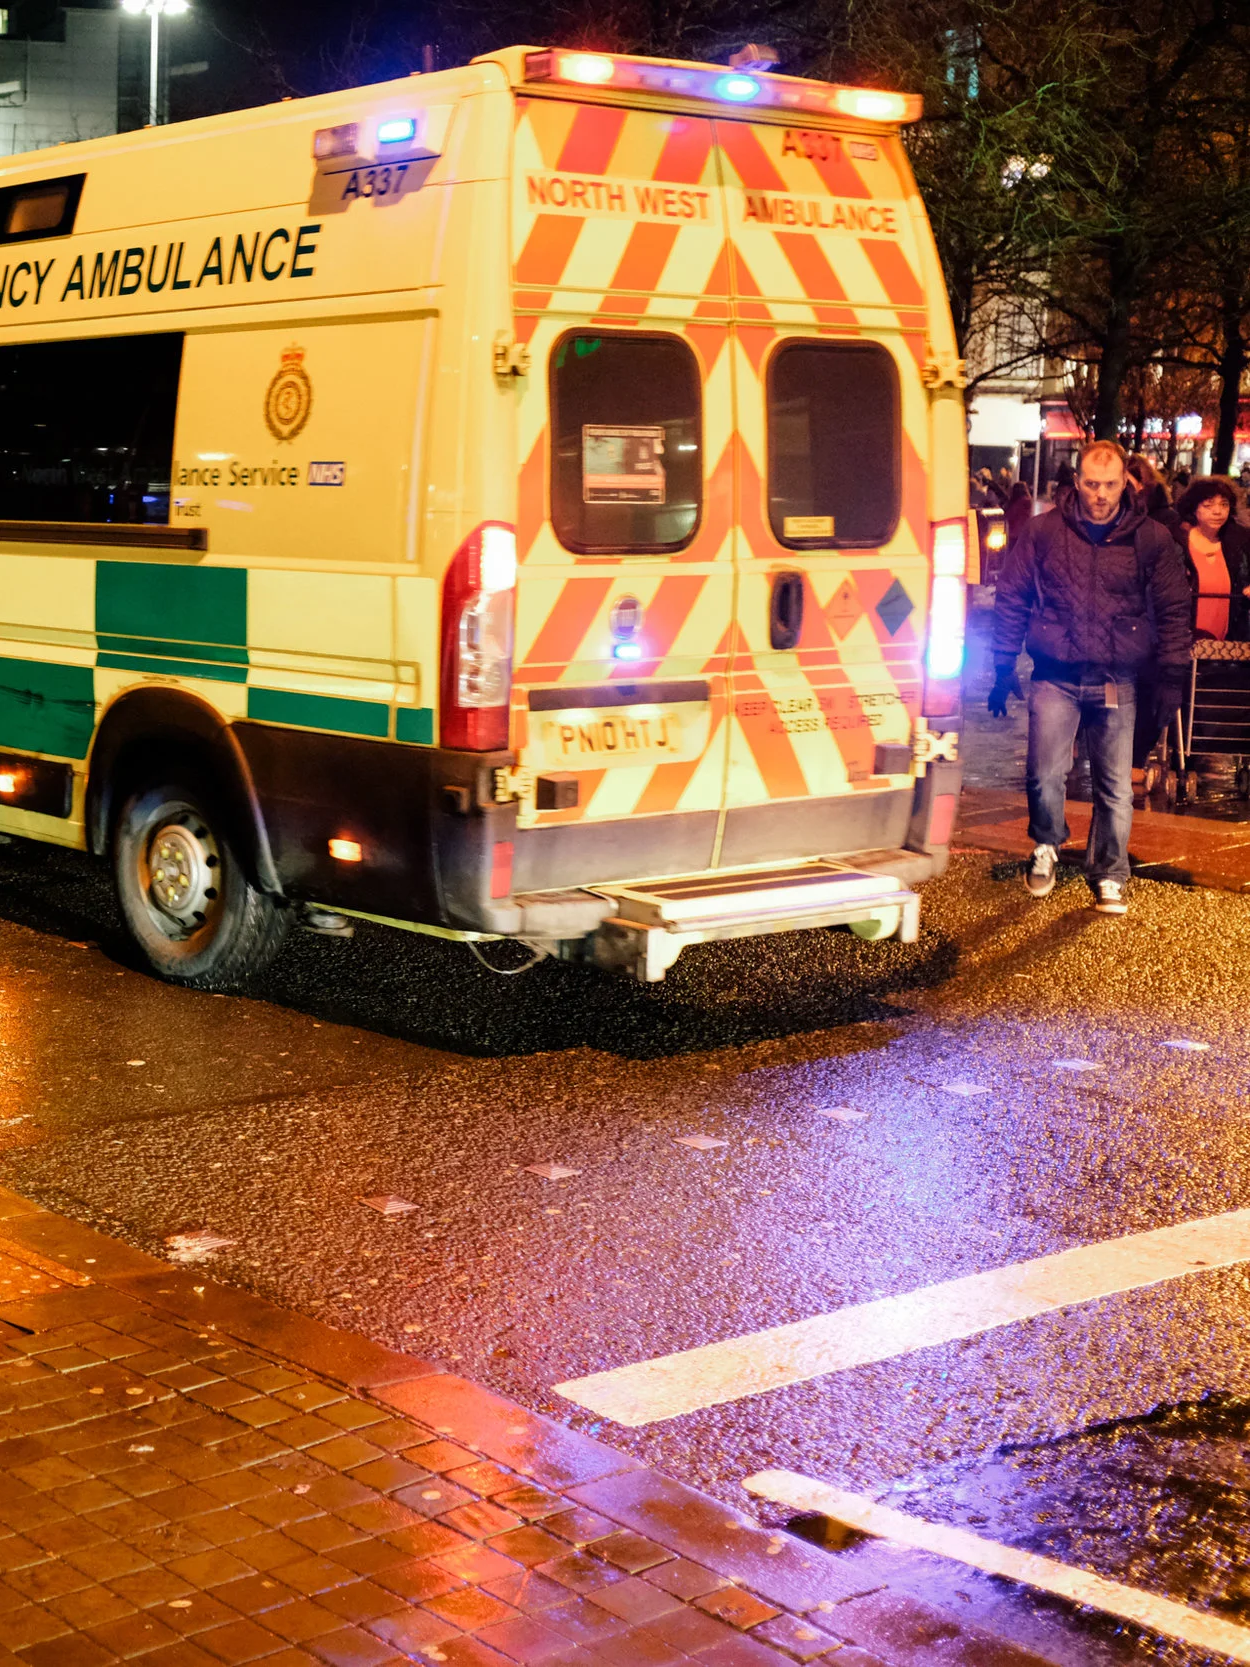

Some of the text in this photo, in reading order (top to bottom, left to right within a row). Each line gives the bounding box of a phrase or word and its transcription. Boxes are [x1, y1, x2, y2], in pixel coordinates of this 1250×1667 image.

[781, 129, 842, 164] A337
[341, 164, 410, 200] A337
[526, 174, 896, 235] NORTH WEST AMBULANCE
[61, 223, 322, 302] AMBULANCE
[227, 460, 300, 486] Service
[308, 461, 344, 486] NHS
[174, 500, 202, 517] Trust
[772, 697, 814, 715] CLEAR
[769, 712, 885, 734] ACCESS REQUIRED
